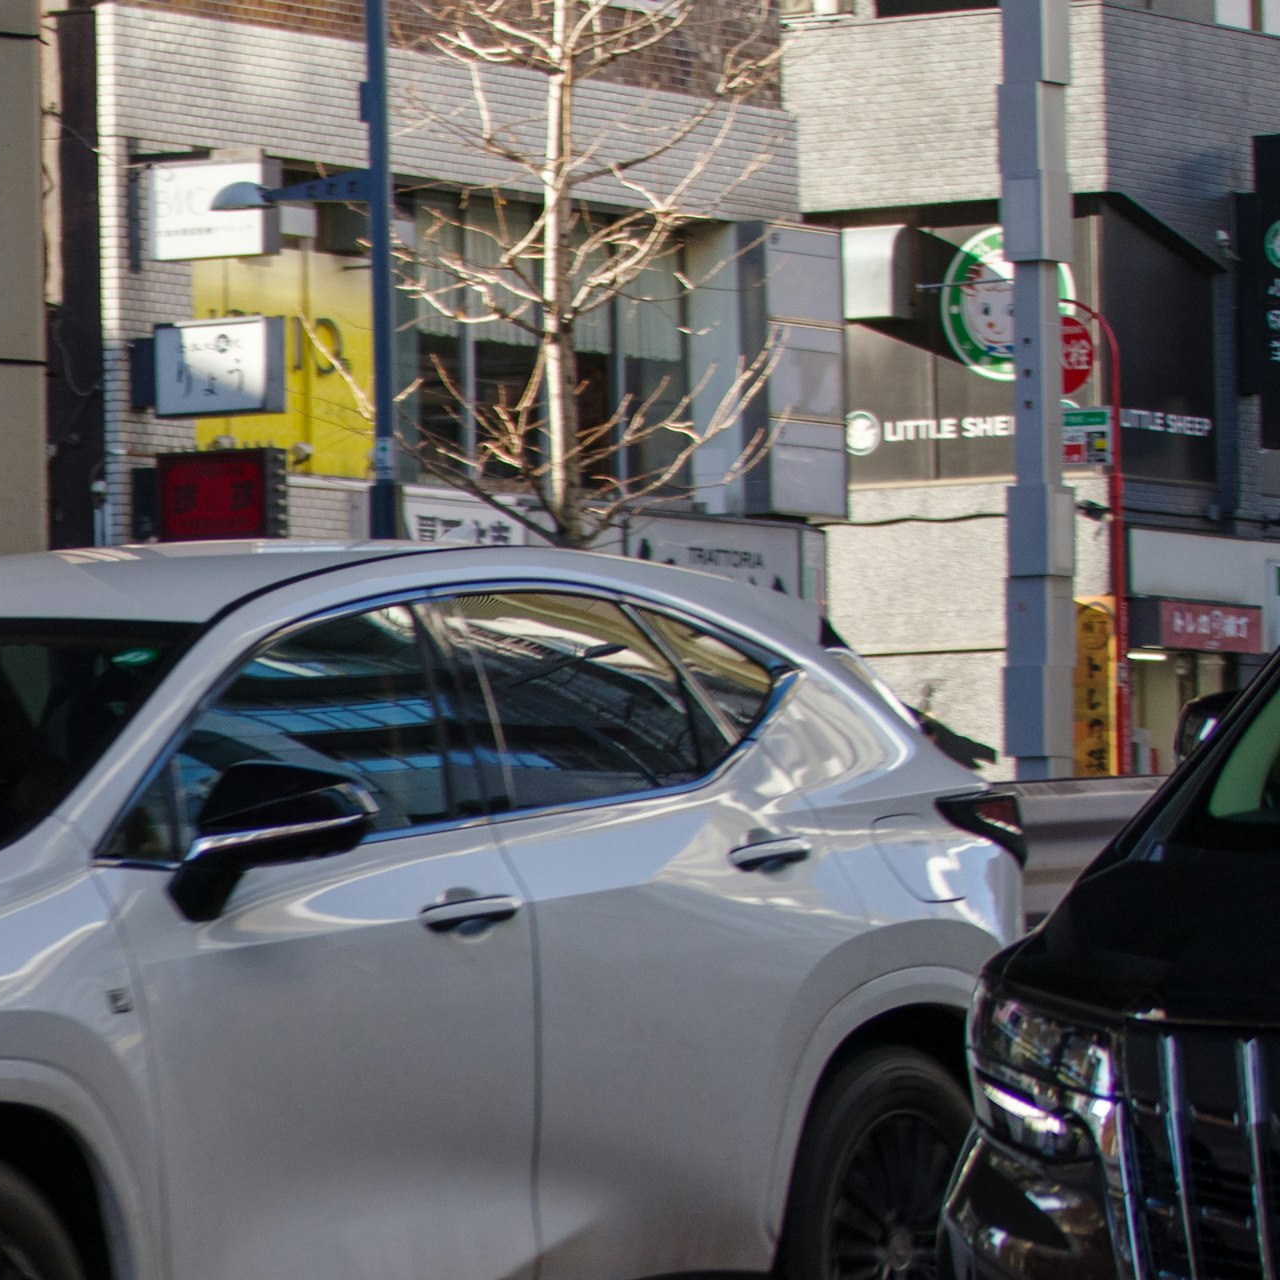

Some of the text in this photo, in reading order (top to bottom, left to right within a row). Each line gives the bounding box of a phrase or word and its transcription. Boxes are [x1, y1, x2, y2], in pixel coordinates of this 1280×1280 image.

[883, 417, 958, 442] LITTLE
[1165, 413, 1213, 437] SHEEP
[687, 546, 765, 570] TRATTORIA
